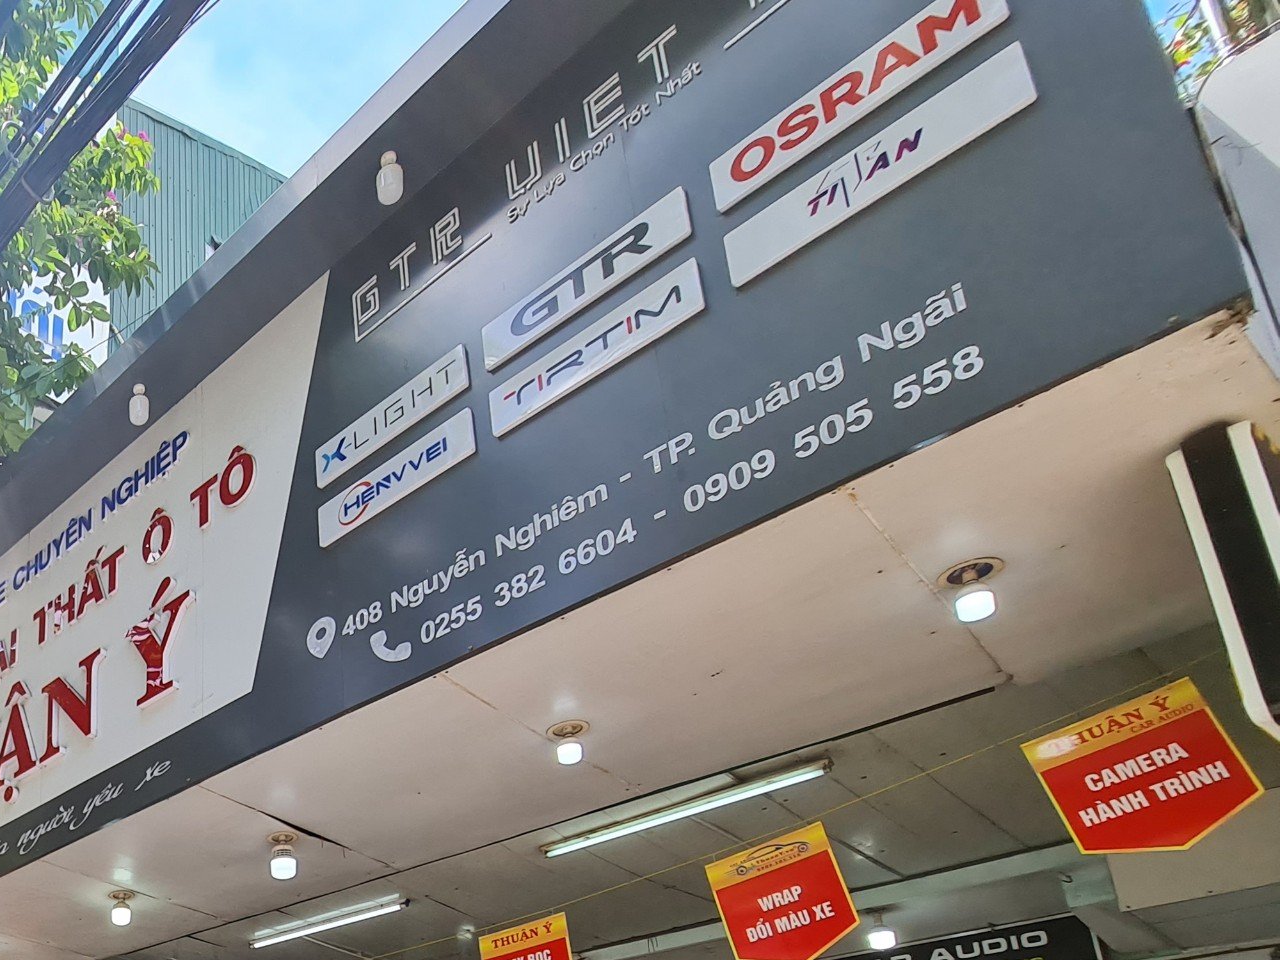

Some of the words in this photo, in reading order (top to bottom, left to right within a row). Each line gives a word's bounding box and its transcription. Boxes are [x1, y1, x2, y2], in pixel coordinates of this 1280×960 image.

[569, 133, 616, 172] Chọn
[618, 102, 650, 132] Tốt
[654, 60, 702, 105] Nhất
[729, 0, 982, 183] OSRAM
[509, 222, 653, 337] GTR
[503, 284, 682, 406] TIRTIM
[321, 359, 457, 474] X-LIGHT
[341, 600, 383, 636] 408
[389, 547, 486, 613] Nguyễn
[495, 482, 610, 557] Nghiêm
[643, 432, 696, 473] TP.
[708, 355, 845, 440] Quảng
[856, 281, 968, 363] Ngãi
[12, 506, 93, 592] CHUYÊN
[100, 430, 191, 522] NGHIỆP
[32, 544, 127, 646] THẤT
[141, 506, 175, 566] Ô
[189, 445, 257, 530] TÔ
[420, 596, 483, 644] 0255
[494, 564, 547, 607] 382
[558, 517, 638, 575] 6604
[683, 449, 776, 513] 0909
[793, 398, 874, 459] 505
[892, 345, 984, 410] 558
[124, 576, 197, 708] Ý
[1131, 719, 1155, 735] CAR
[1157, 703, 1195, 723] AUDIO
[1148, 695, 1171, 714] Ý
[17, 805, 75, 855] người
[69, 782, 124, 831] yêu
[135, 760, 172, 792] xe
[1078, 789, 1151, 829] HÀNH
[1149, 760, 1232, 802] TRÌNH
[1084, 742, 1190, 793] CAMERA
[491, 927, 539, 949] THUẬN
[543, 921, 554, 934] Ý
[745, 918, 774, 943] ĐỔI
[774, 909, 811, 934] MÀU
[812, 901, 836, 921] XE
[757, 885, 803, 912] WRAP
